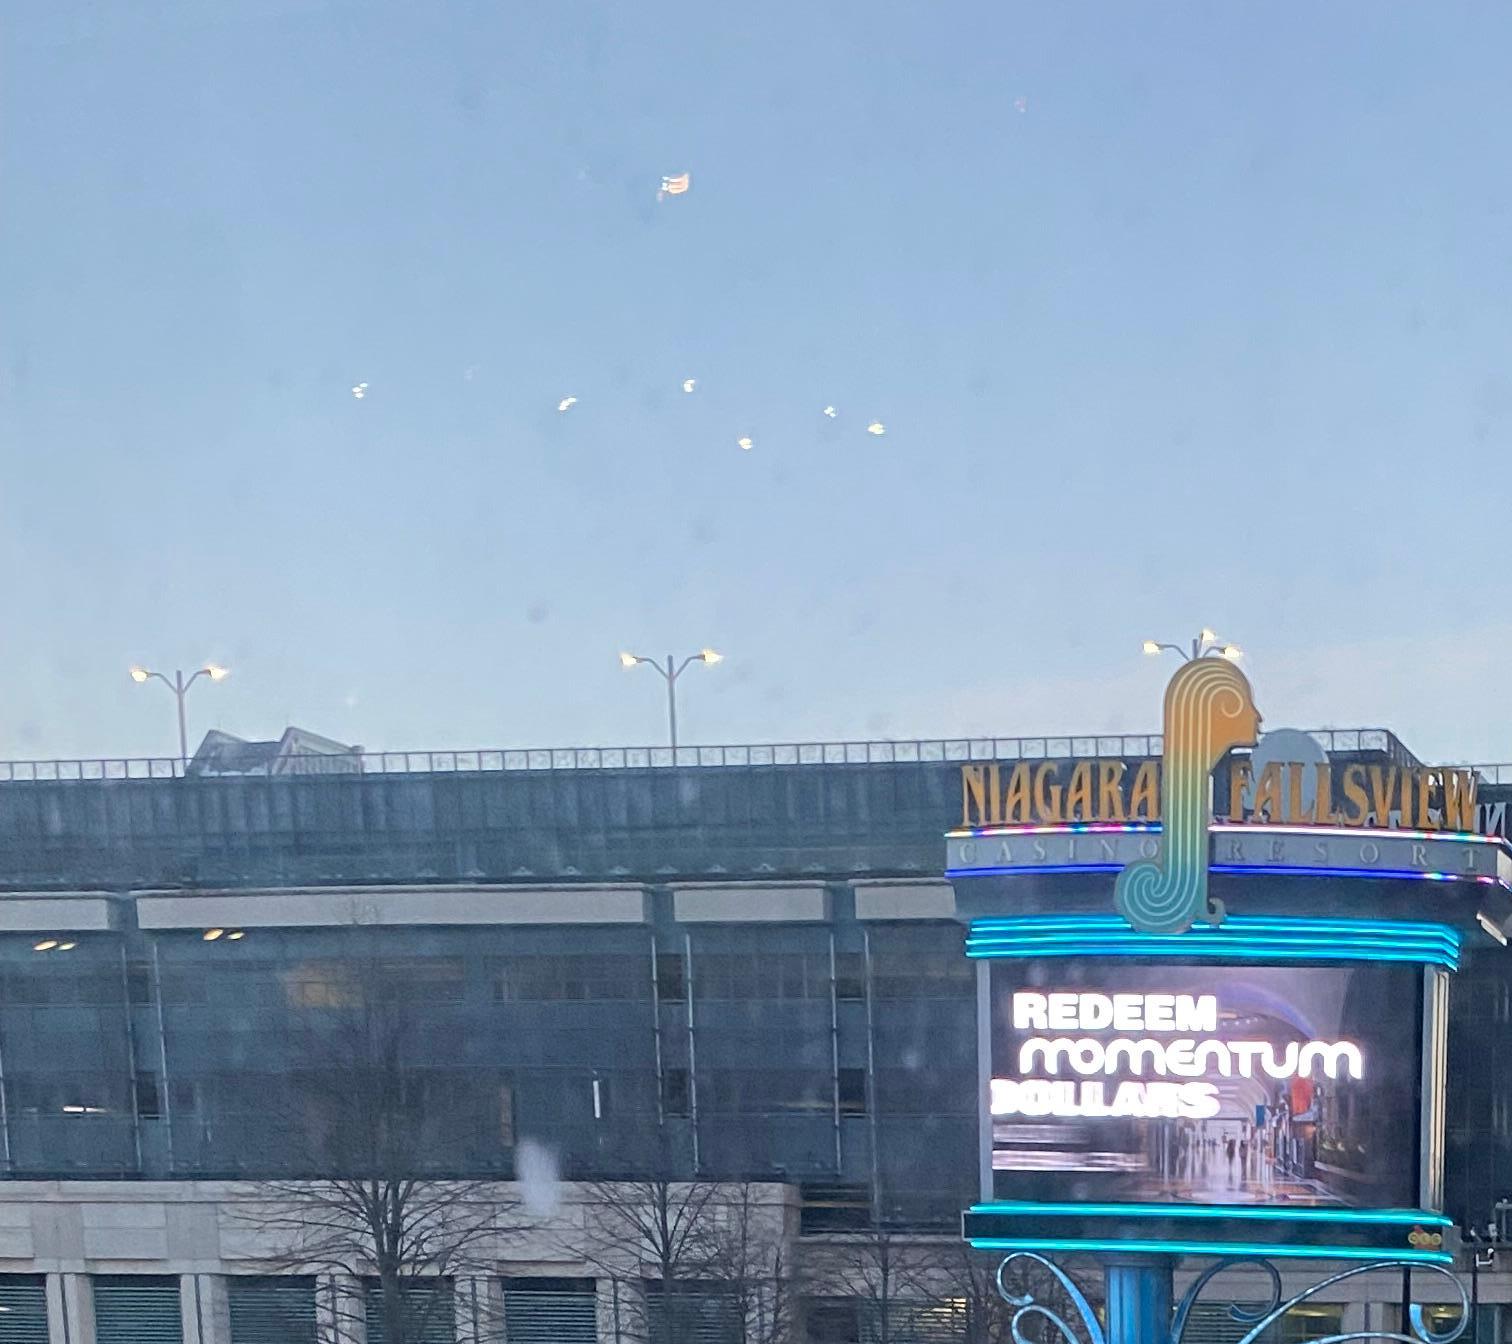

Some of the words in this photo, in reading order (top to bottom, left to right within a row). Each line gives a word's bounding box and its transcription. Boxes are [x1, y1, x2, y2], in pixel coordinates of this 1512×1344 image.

[961, 760, 1160, 827] NIAGARA
[1229, 760, 1480, 832] FALLSVIEW
[959, 838, 1159, 864] CASINO
[1225, 839, 1481, 870] RESORT
[1012, 992, 1217, 1032] REDEEM
[990, 1078, 1221, 1119] DOLLARS
